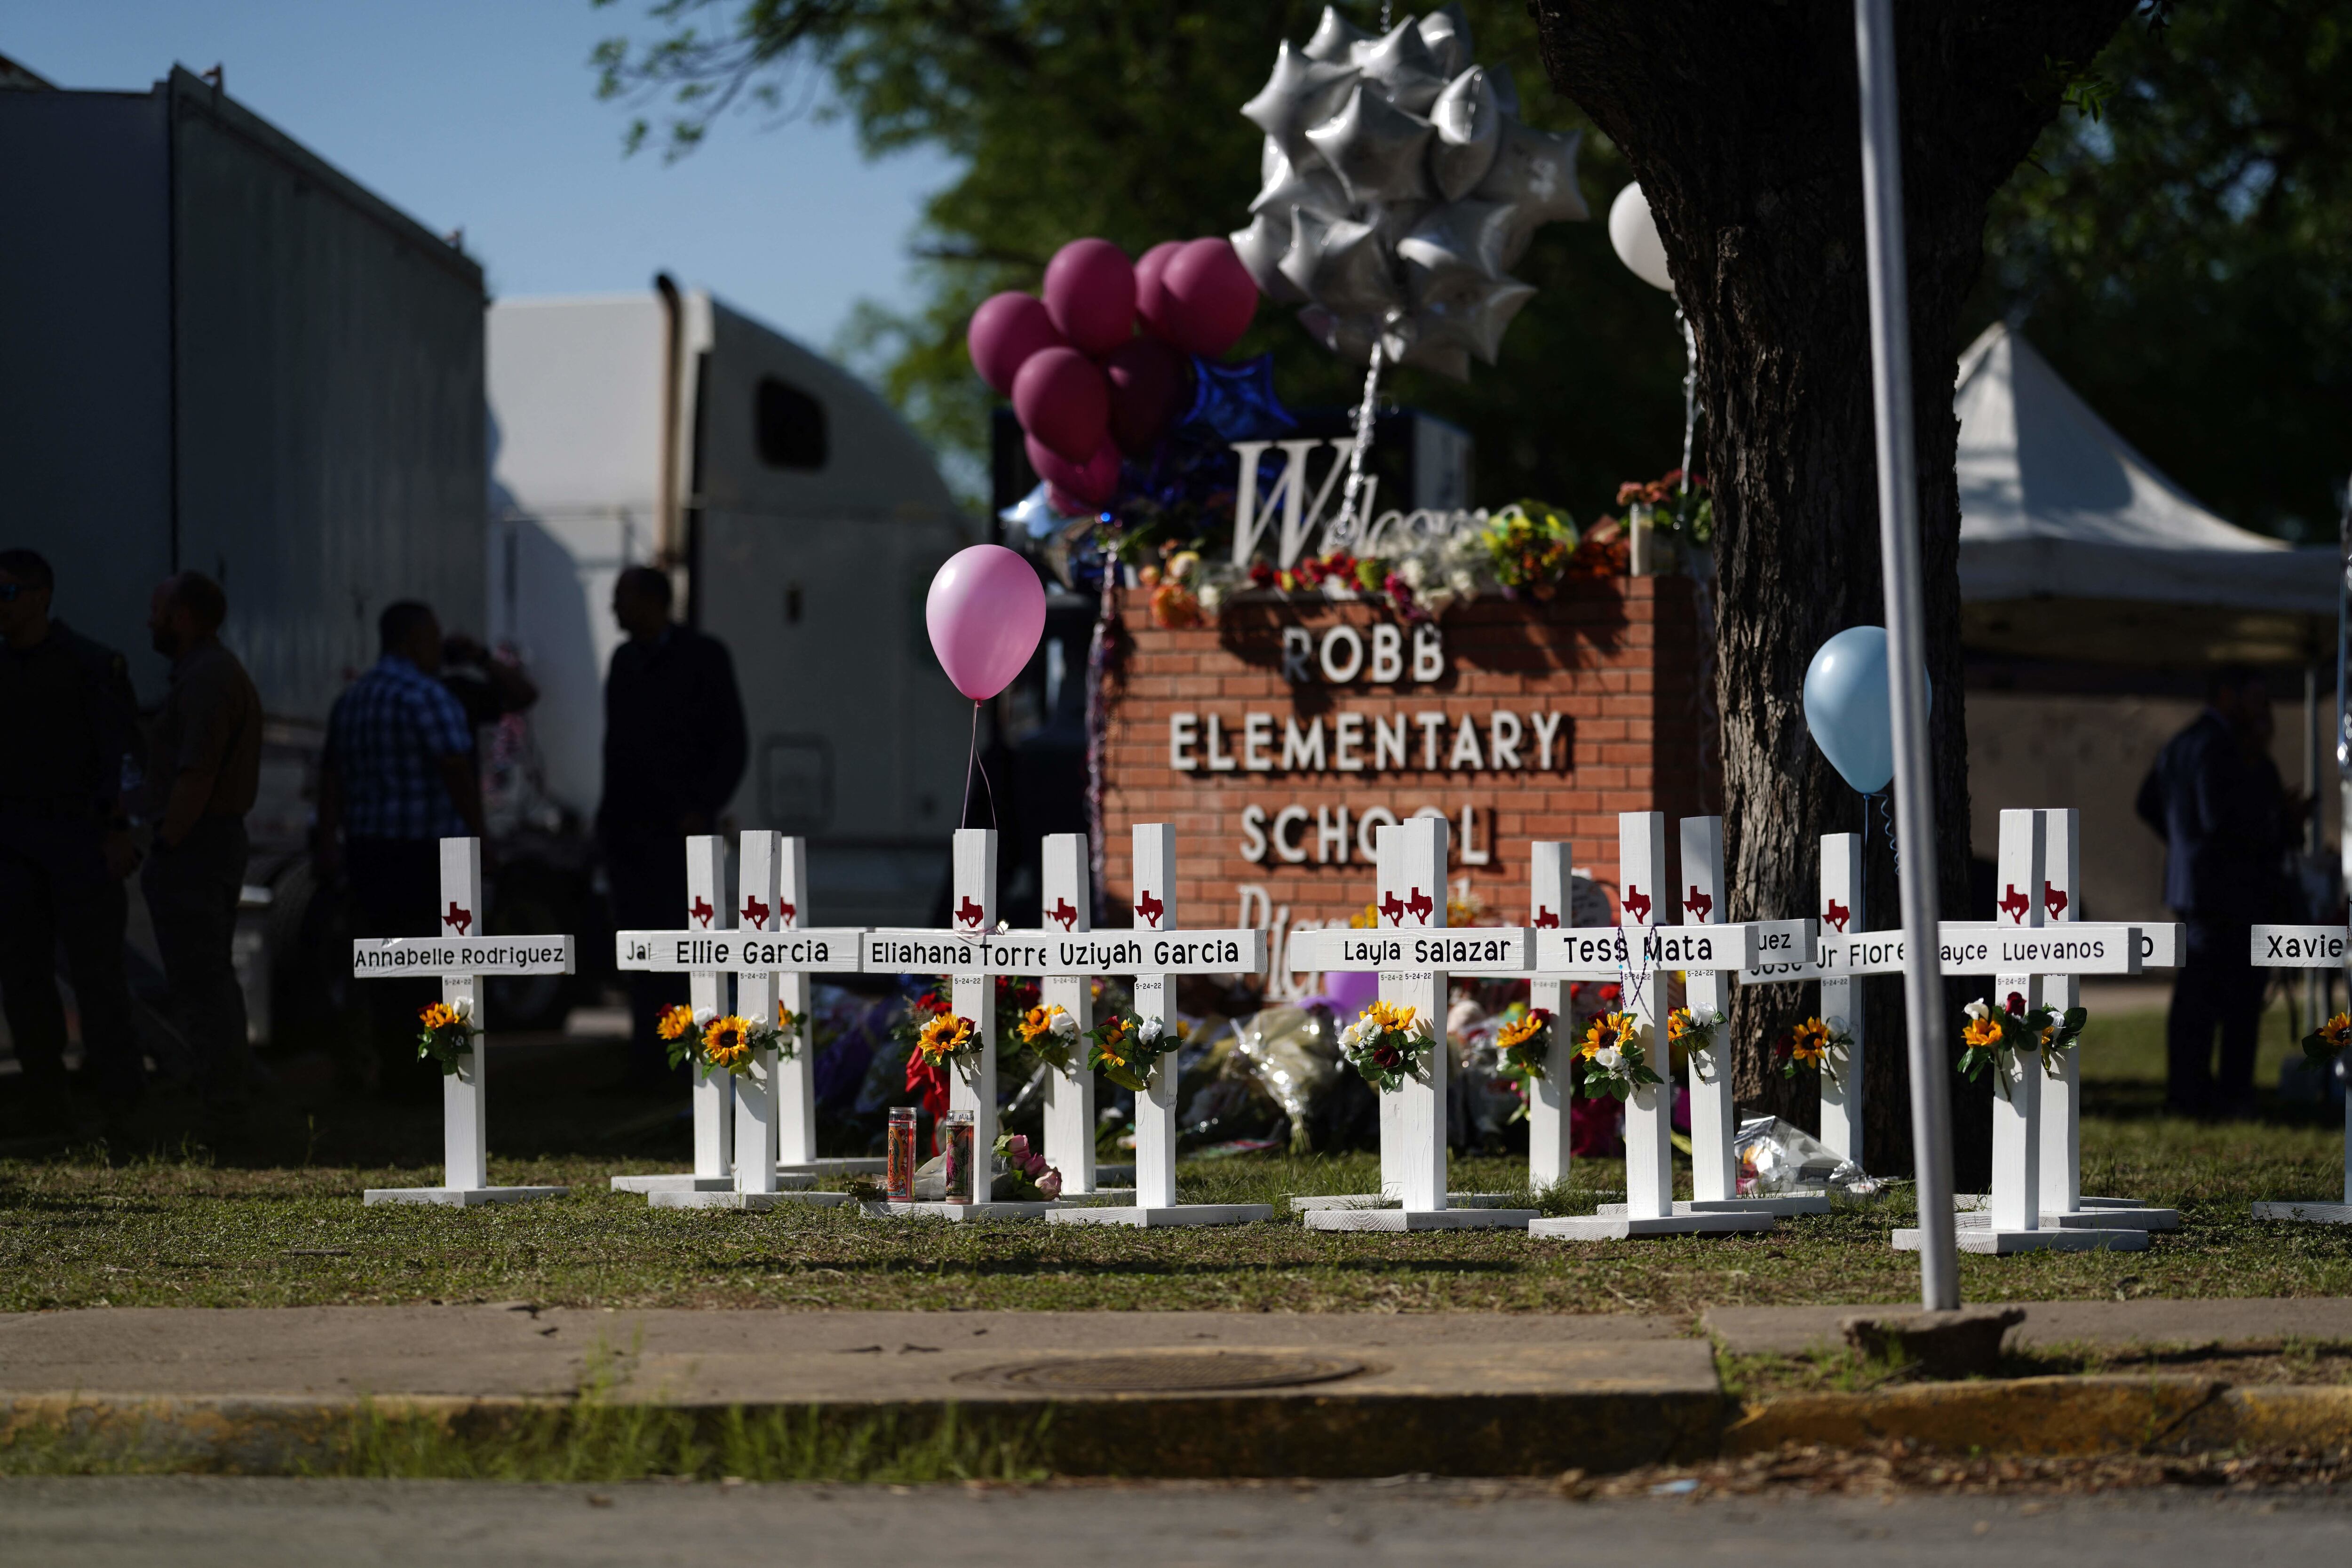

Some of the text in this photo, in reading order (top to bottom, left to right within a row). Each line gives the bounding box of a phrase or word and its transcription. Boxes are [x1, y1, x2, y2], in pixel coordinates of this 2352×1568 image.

[1232, 437, 1525, 570] Welco
[1282, 623, 1444, 683] ROBB
[1169, 710, 1562, 771] ELEMENTARY
[1240, 804, 1489, 865] SCHOL
[354, 947, 564, 967] Annabelle Rodriguez
[677, 940, 828, 964] Ellie Garcia
[873, 942, 1046, 966] Eliahana Torre
[1061, 940, 1238, 970] Uziyah Garcia
[1345, 939, 1510, 965] Layla Salazar
[1564, 935, 1712, 963] Tess Mata
[1817, 945, 1837, 968] Jr
[2004, 941, 2104, 961] Luevanos
[2267, 934, 2343, 958] Xavie
